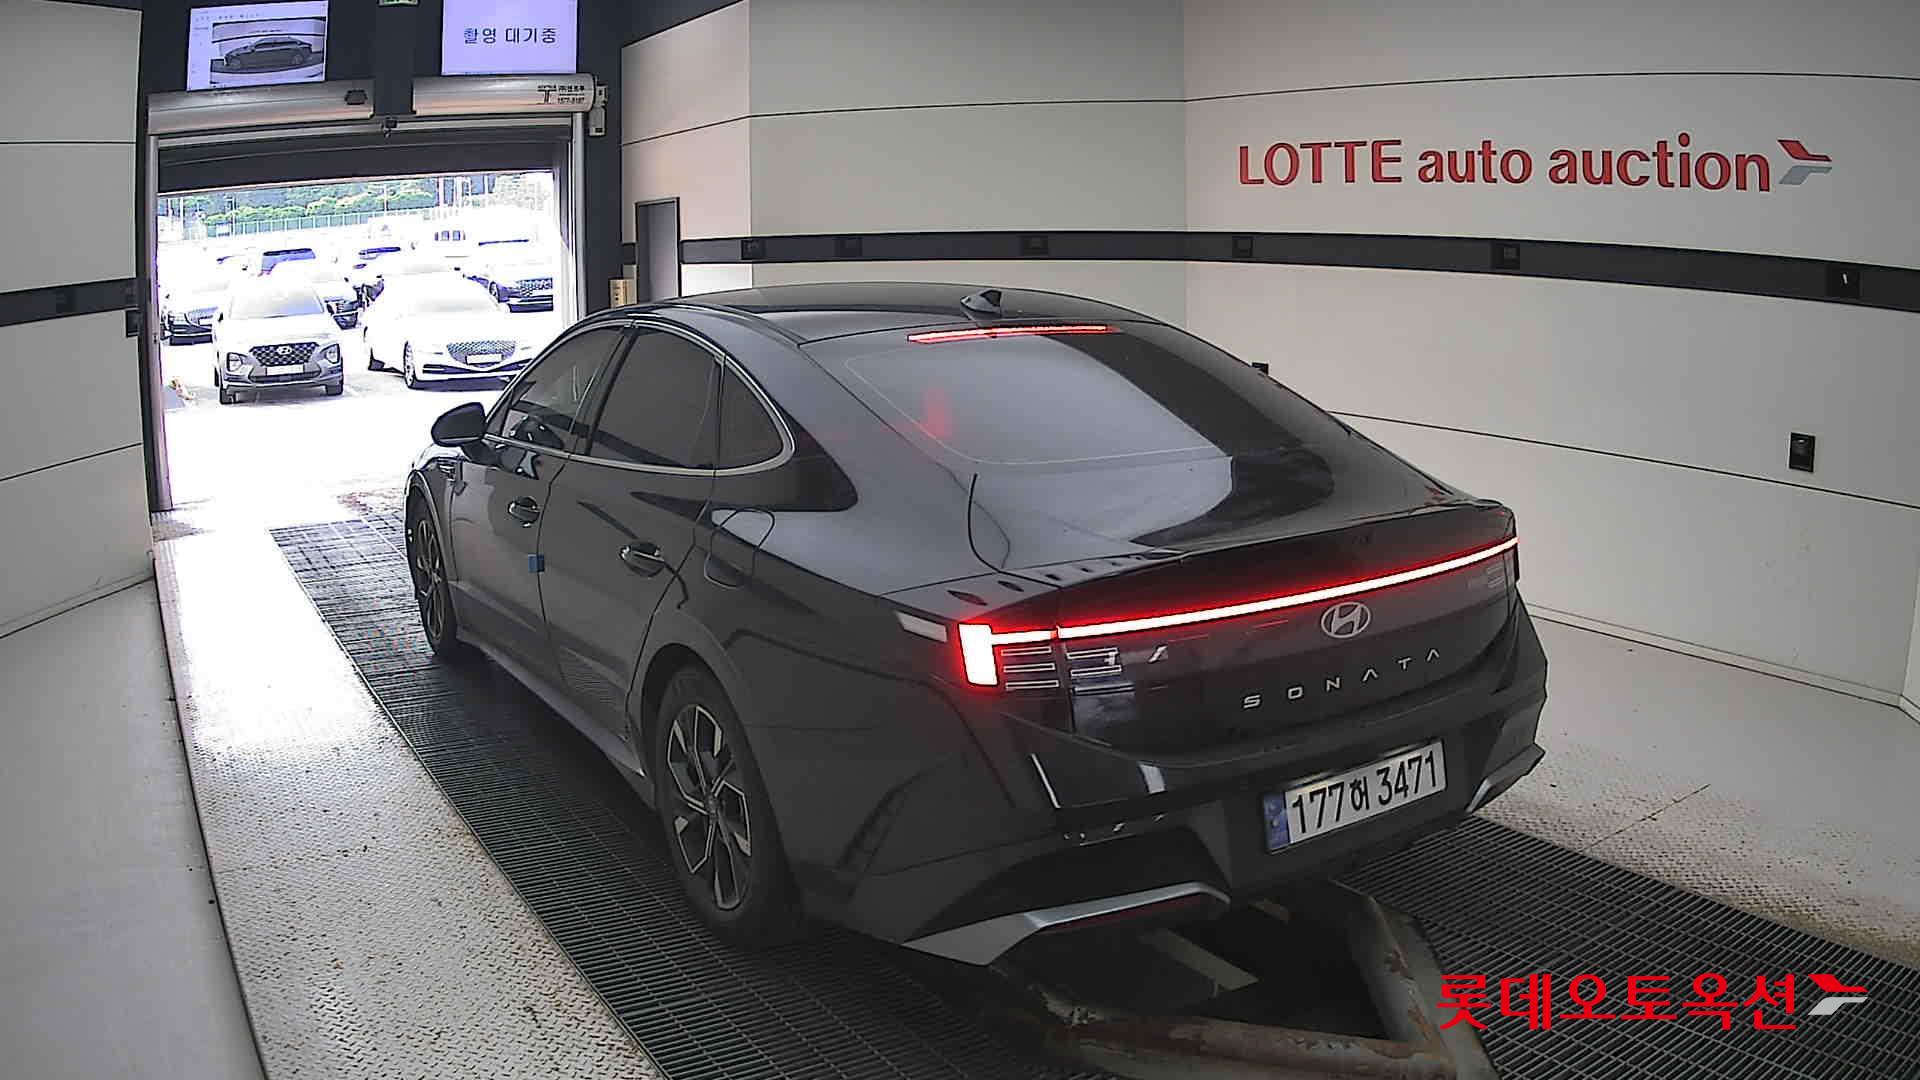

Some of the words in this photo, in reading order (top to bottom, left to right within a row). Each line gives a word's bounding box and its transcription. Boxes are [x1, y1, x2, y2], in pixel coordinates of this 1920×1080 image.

[464, 27, 497, 44] 촬영
[505, 27, 556, 44] 대기중
[1239, 139, 1402, 186] LOTTE
[1417, 140, 1533, 185] auto
[1548, 133, 1771, 193] auction
[1243, 648, 1440, 709] SONATA
[1292, 776, 1370, 834] 177허
[1376, 750, 1436, 806] 3471
